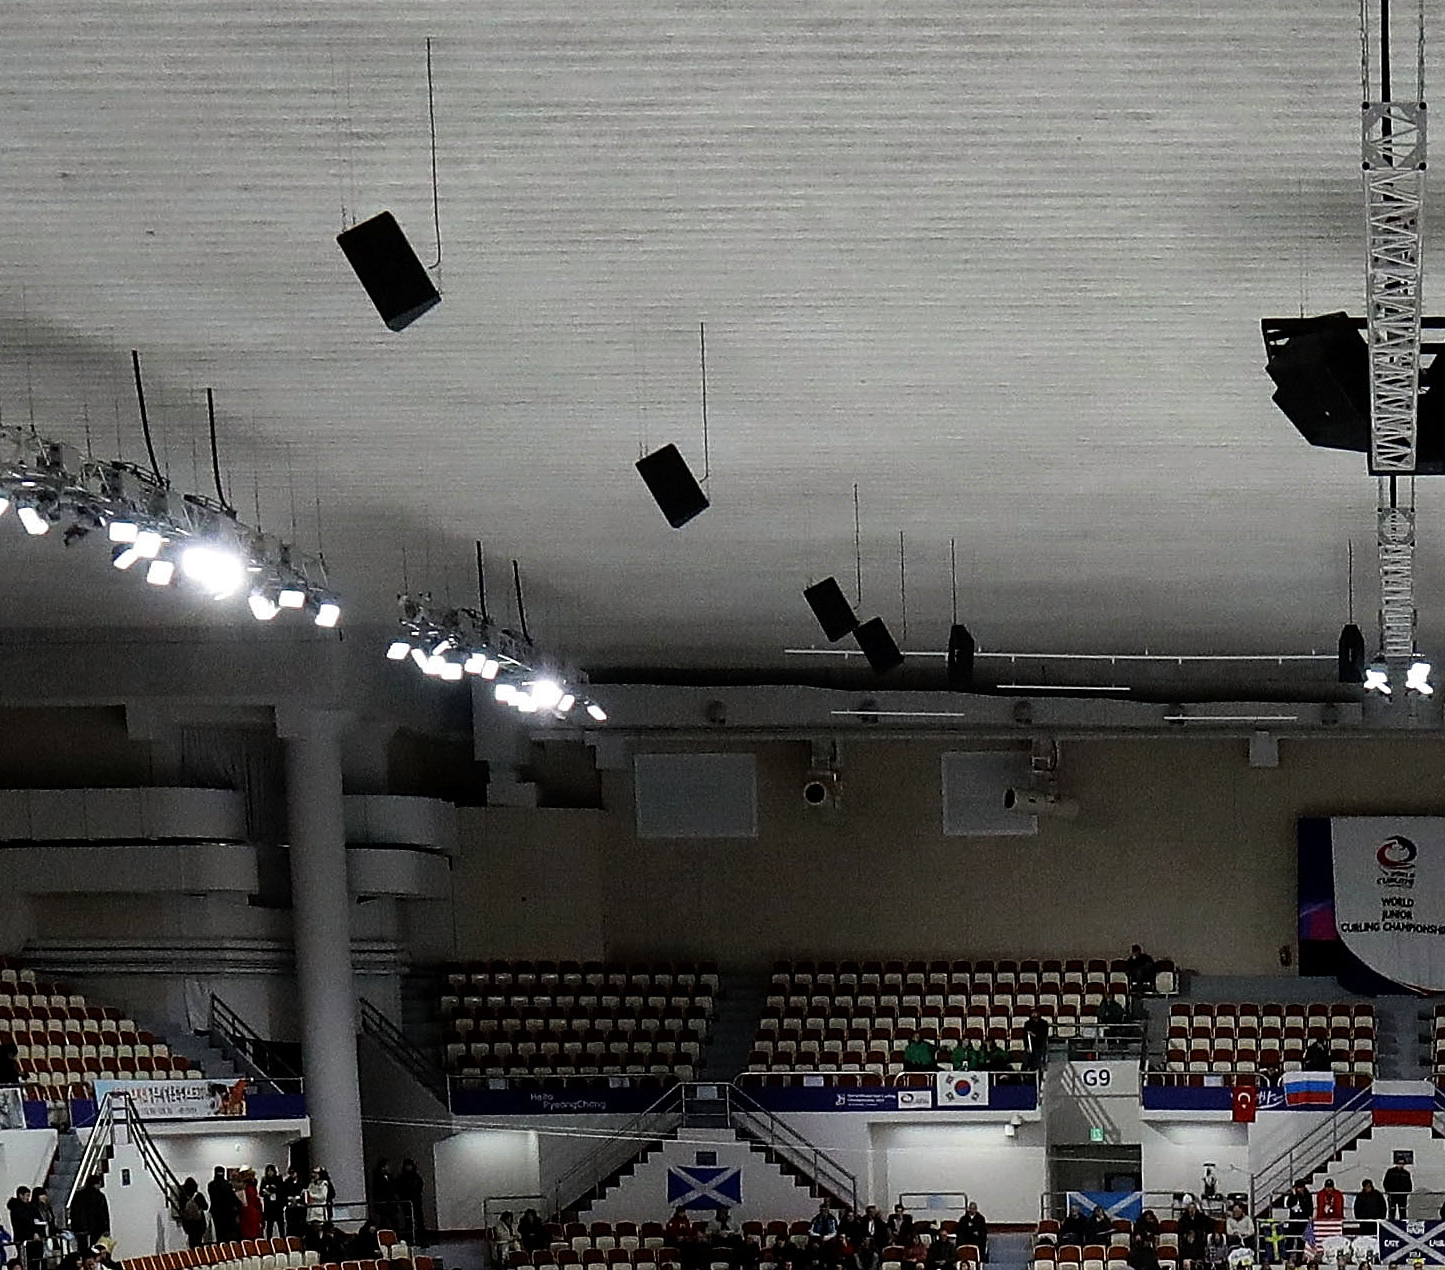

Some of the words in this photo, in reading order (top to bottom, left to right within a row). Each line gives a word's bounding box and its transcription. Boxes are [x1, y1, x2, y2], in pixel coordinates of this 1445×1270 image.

[1381, 897, 1414, 907] WORLD
[1382, 910, 1412, 920] JUNIOR
[1341, 922, 1380, 932] CURLING
[1083, 1070, 1111, 1086] G9
